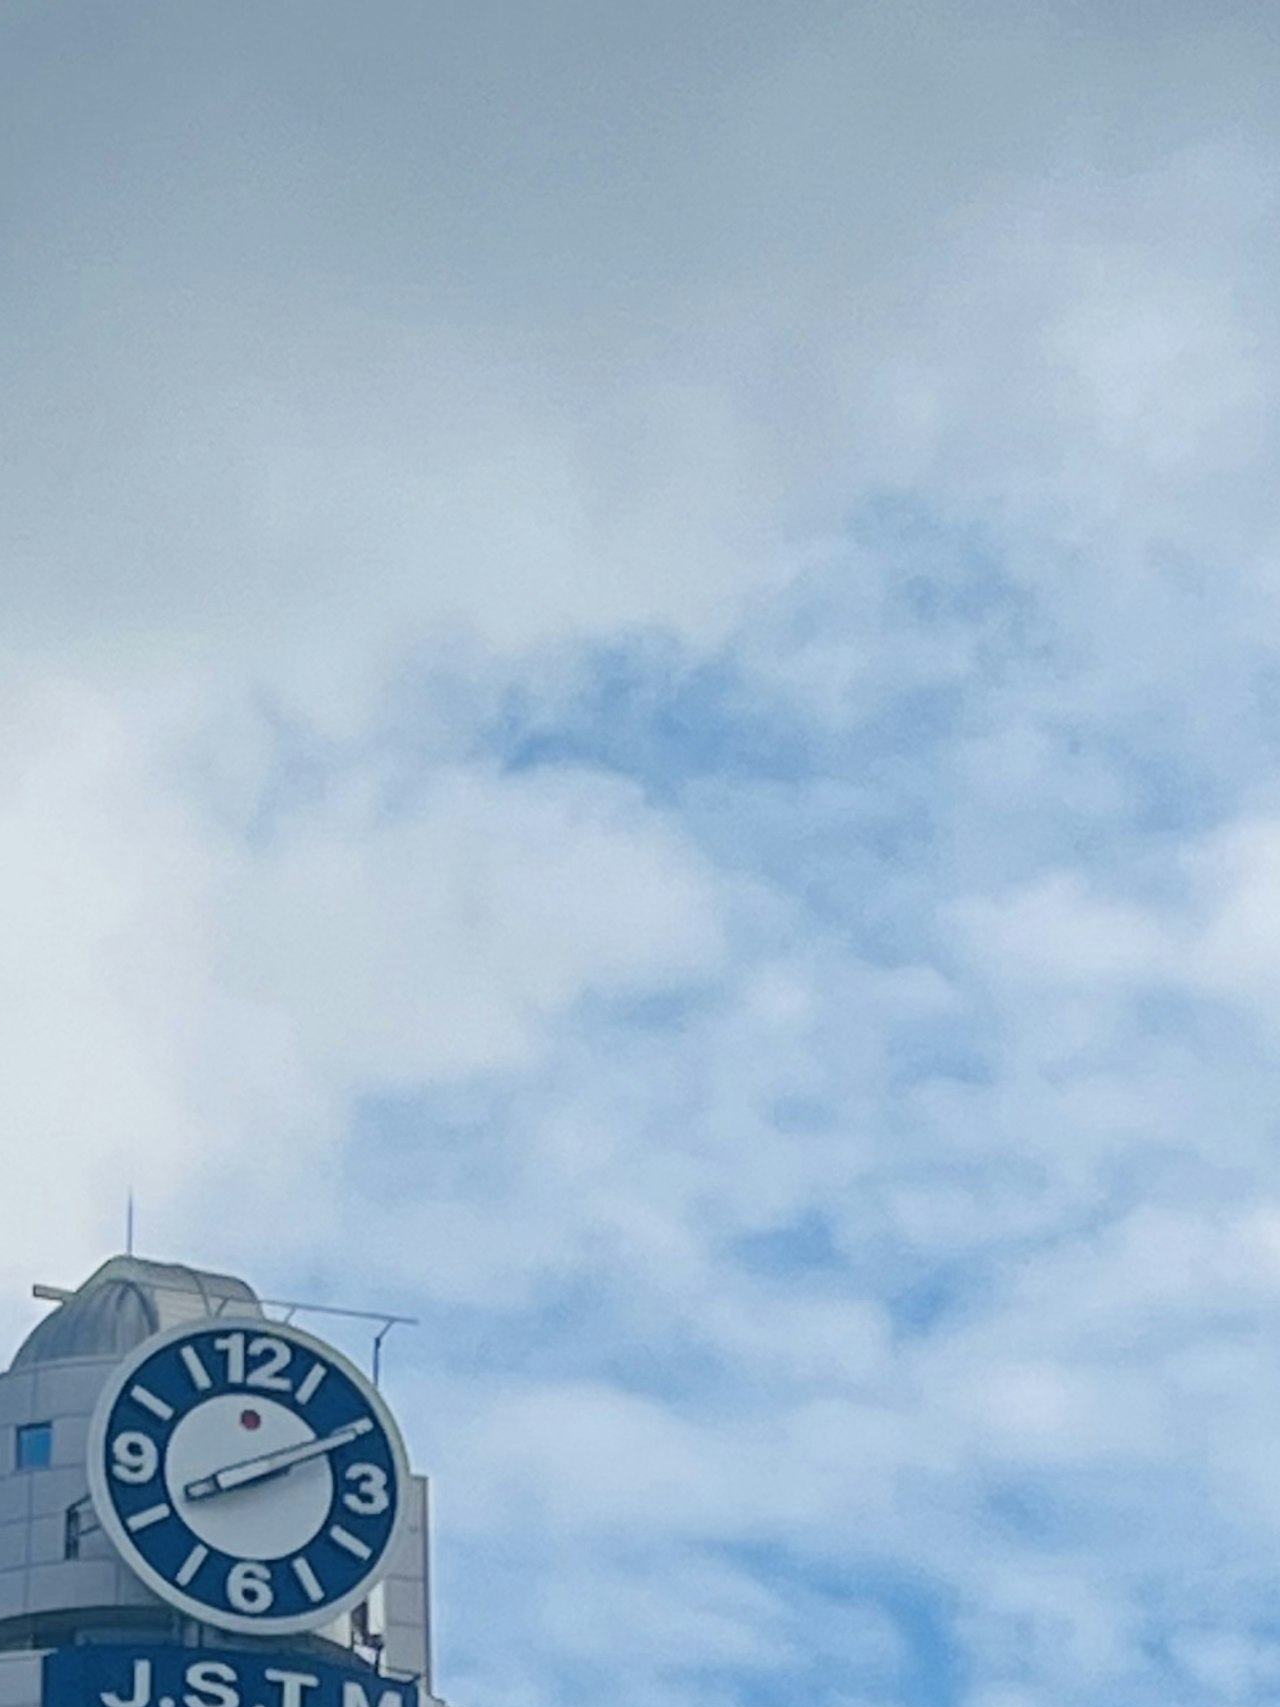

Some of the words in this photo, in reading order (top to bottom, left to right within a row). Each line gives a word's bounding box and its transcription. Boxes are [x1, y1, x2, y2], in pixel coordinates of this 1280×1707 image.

[214, 1333, 292, 1392] 12
[112, 1431, 158, 1484] 9
[343, 1462, 389, 1515] 3
[226, 1561, 273, 1613] 6
